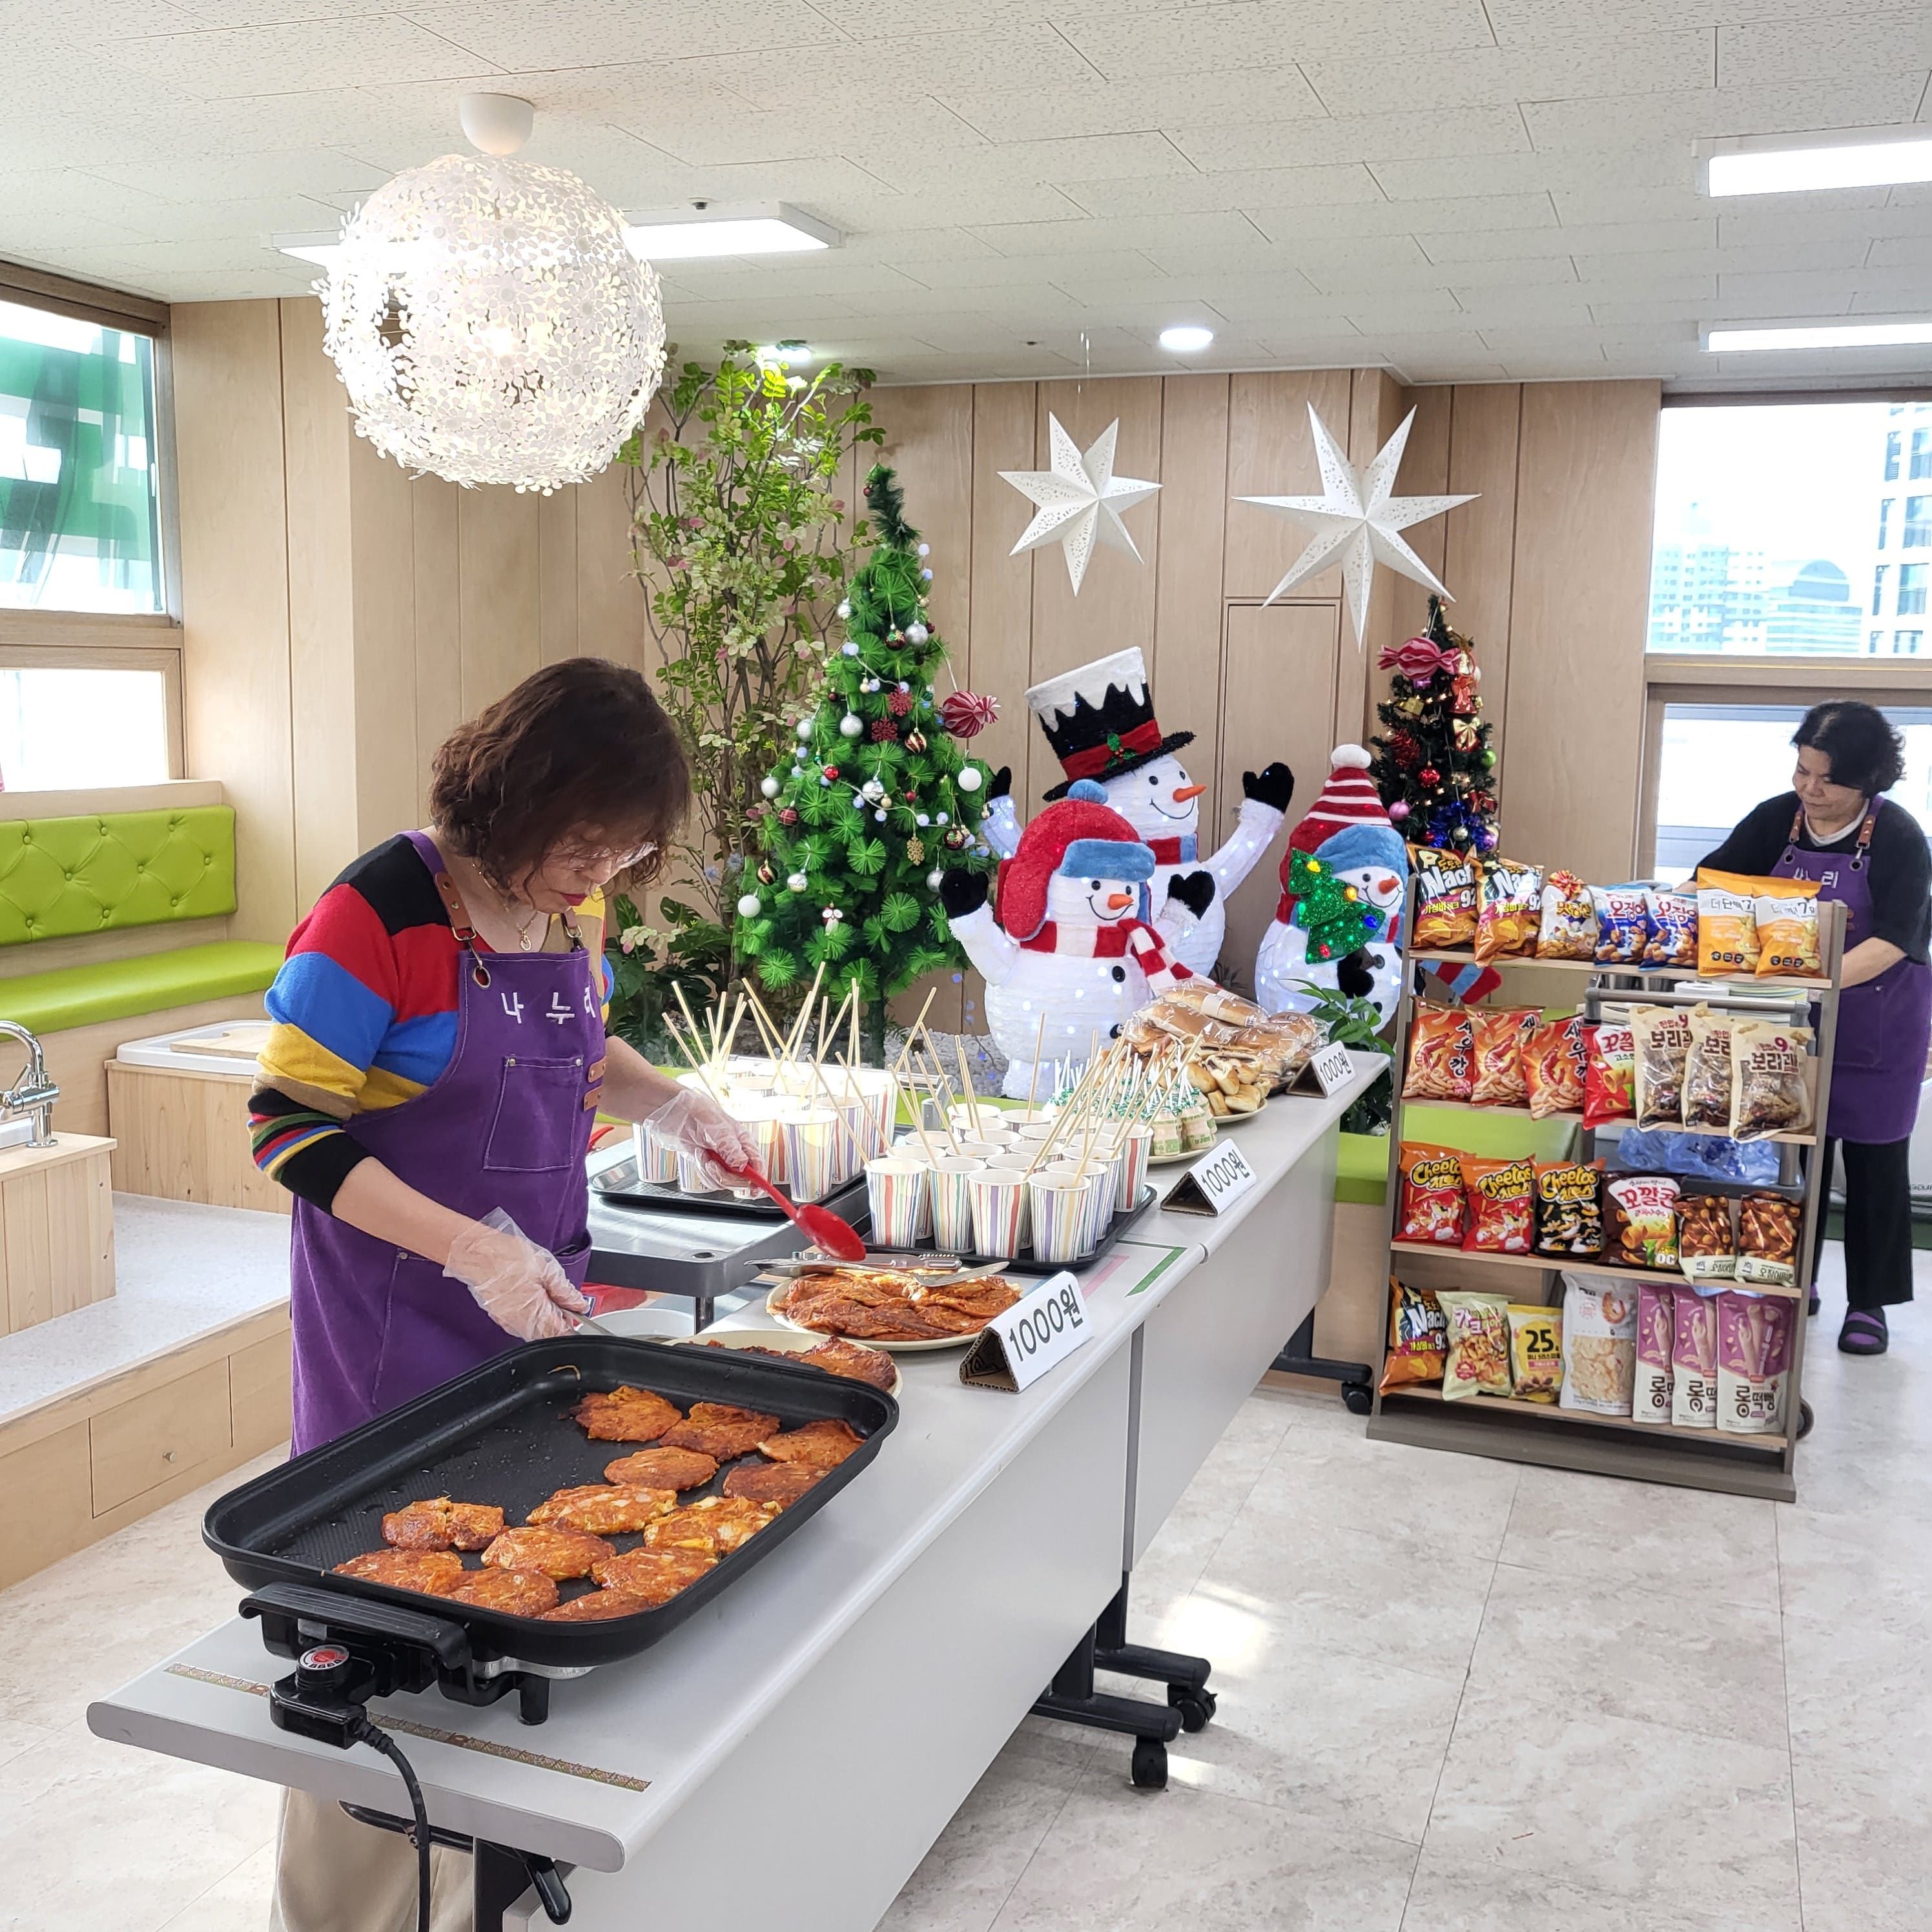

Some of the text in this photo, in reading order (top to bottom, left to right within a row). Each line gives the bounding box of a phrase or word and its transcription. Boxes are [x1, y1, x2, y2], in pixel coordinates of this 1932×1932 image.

[1319, 1050, 1352, 1085] 1000원
[1201, 1149, 1250, 1197] 1000원
[1541, 1166, 1597, 1199] Cheetos
[1618, 1187, 1676, 1210] 꼬깔콘
[1009, 1284, 1084, 1362] 1000원
[1526, 1329, 1554, 1352] 25
